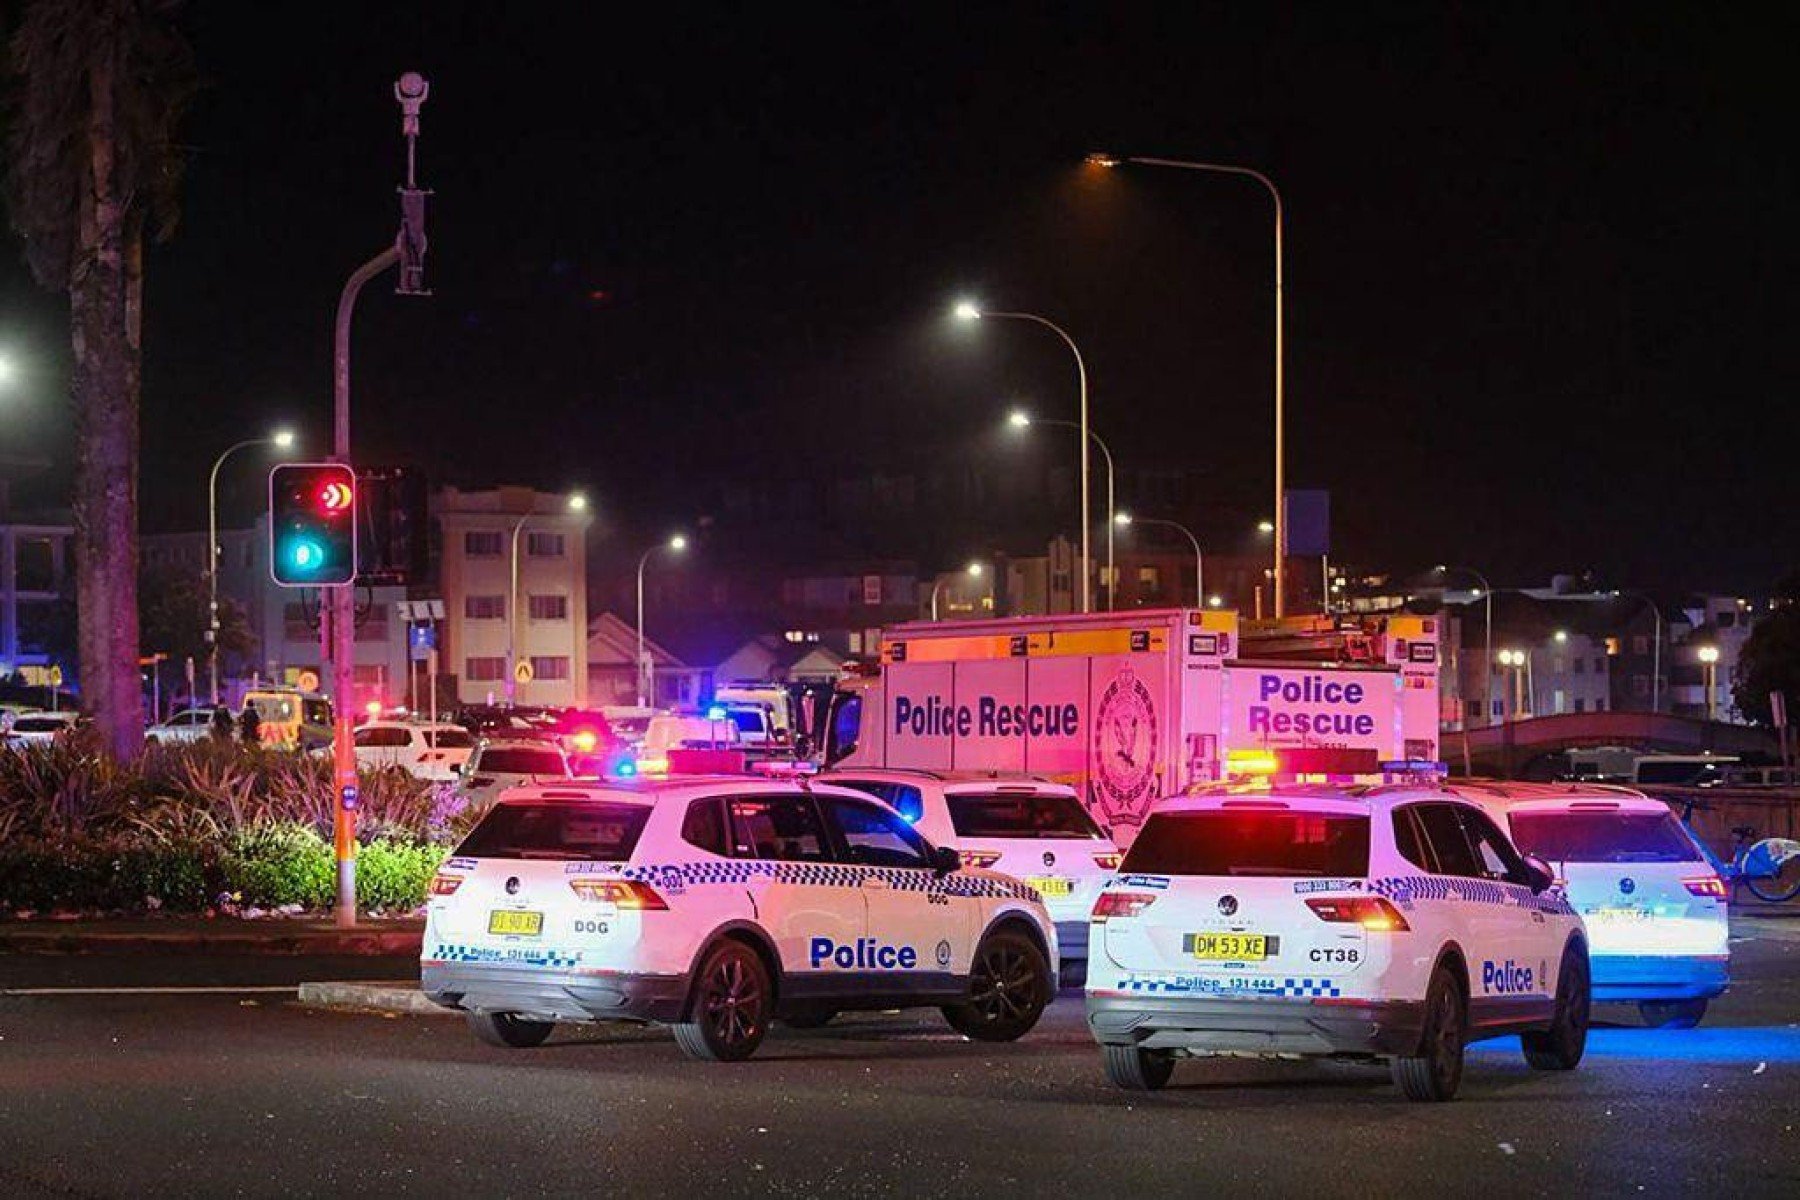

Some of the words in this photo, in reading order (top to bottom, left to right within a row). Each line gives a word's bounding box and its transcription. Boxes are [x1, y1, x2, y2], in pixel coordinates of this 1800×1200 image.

[1259, 674, 1364, 704] Police
[895, 696, 971, 737] Police
[978, 696, 1079, 737] Rescue
[1249, 705, 1374, 735] Rescue
[574, 919, 609, 934] DOG
[811, 938, 917, 969] Police
[1196, 936, 1217, 955] DM
[1220, 937, 1240, 955] 53
[1243, 937, 1264, 956] XE
[1308, 948, 1359, 963] CT38
[1175, 975, 1221, 988] Police
[1483, 960, 1533, 993] Police
